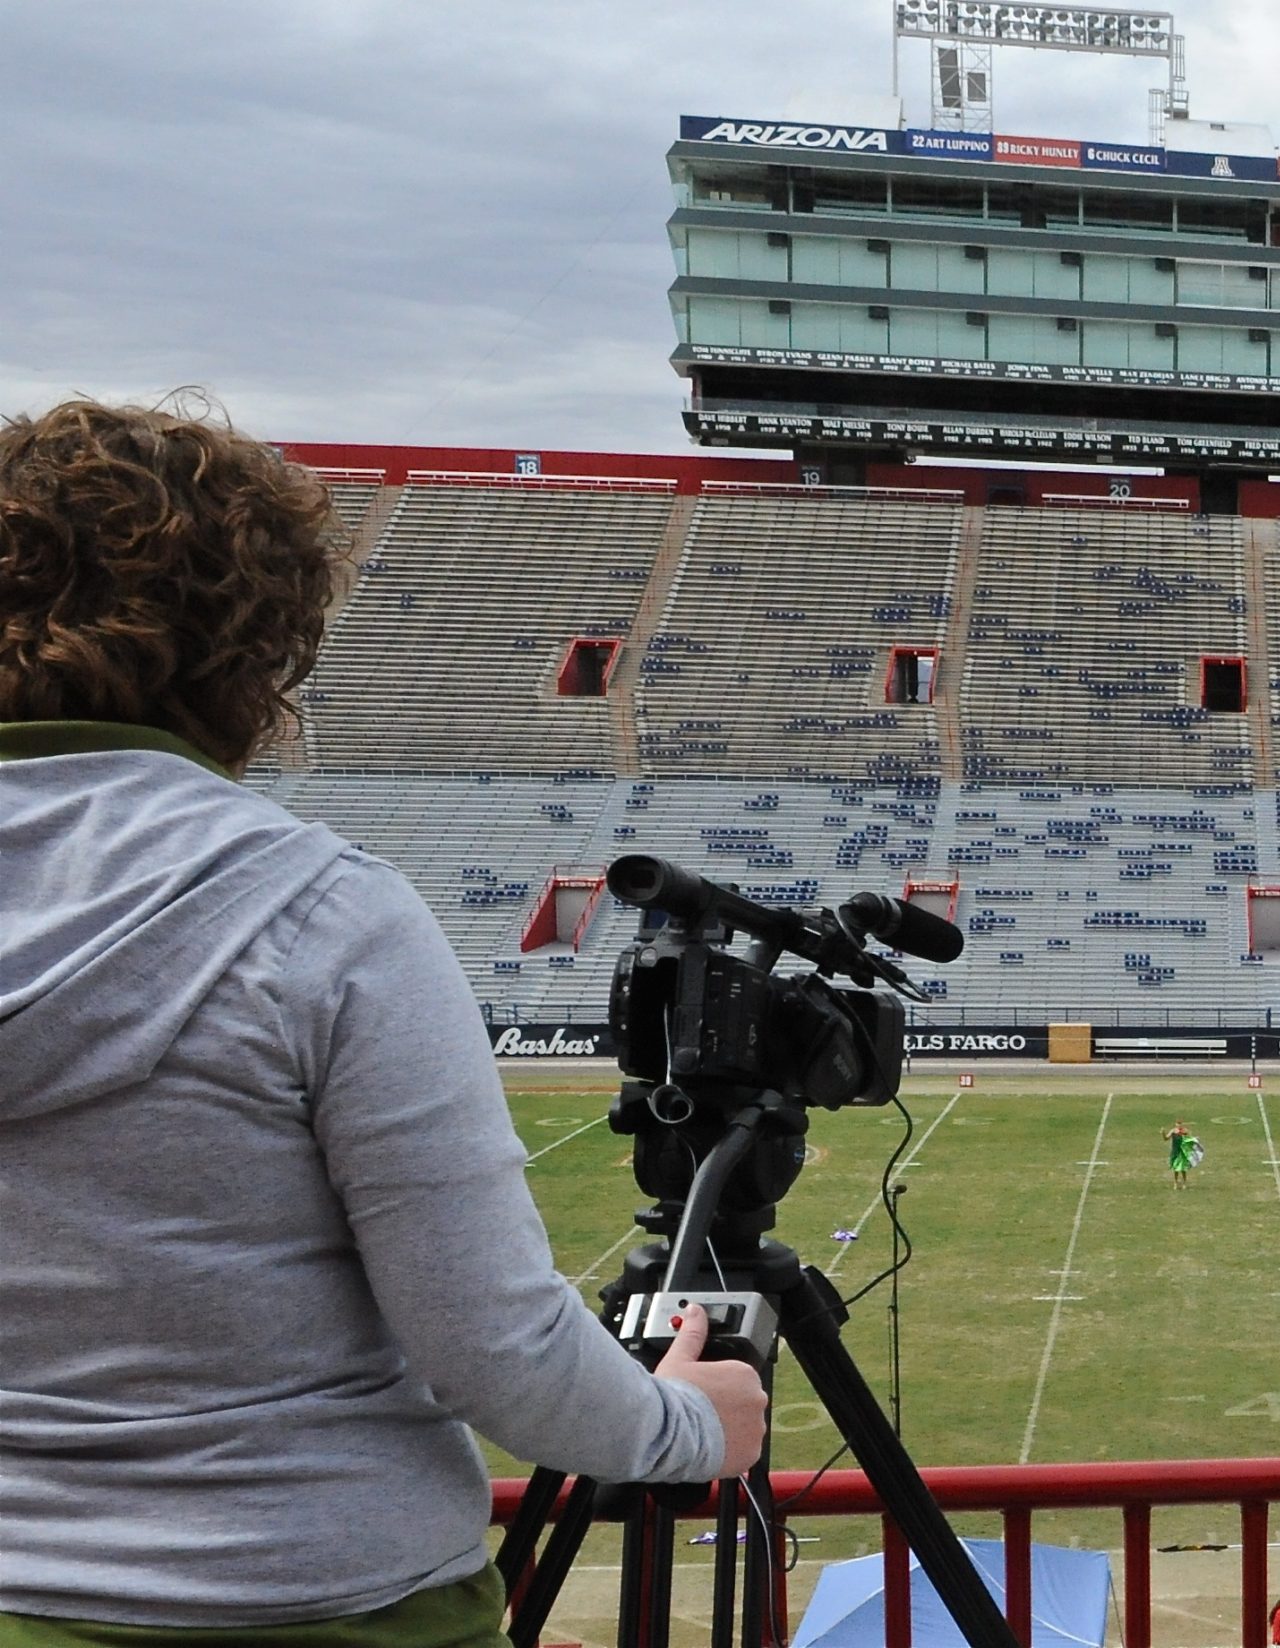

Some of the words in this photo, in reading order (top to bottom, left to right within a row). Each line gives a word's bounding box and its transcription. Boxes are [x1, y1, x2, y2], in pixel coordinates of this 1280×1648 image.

[702, 122, 887, 151] ARIZONA
[913, 136, 924, 148] 22
[926, 138, 944, 149] ART
[948, 139, 989, 152] LUPPINO
[1010, 144, 1039, 155] RICKY
[1042, 146, 1078, 158] HUNLEY
[1096, 150, 1130, 163] CHUCK
[1133, 153, 1160, 165] CECIL
[880, 357, 907, 365] BRANT
[1088, 369, 1113, 377] WELLS
[1236, 377, 1267, 385] ANTONIO
[699, 414, 715, 422] DAVE
[758, 417, 778, 425] HANK
[780, 418, 812, 427] STANTON
[823, 420, 840, 428] WALT
[843, 421, 870, 430] NIELSEN
[887, 423, 905, 431] TONY
[943, 426, 964, 434] ALLAN
[1085, 434, 1111, 442] WILSON
[1142, 436, 1164, 444] BLAND
[1178, 438, 1192, 446] TOM
[518, 461, 537, 475] 18
[802, 471, 820, 485] 19
[1110, 484, 1130, 497] 20
[493, 1027, 600, 1055] Bashas'
[903, 1034, 944, 1050] ELLS
[949, 1034, 1026, 1050] FARGO
